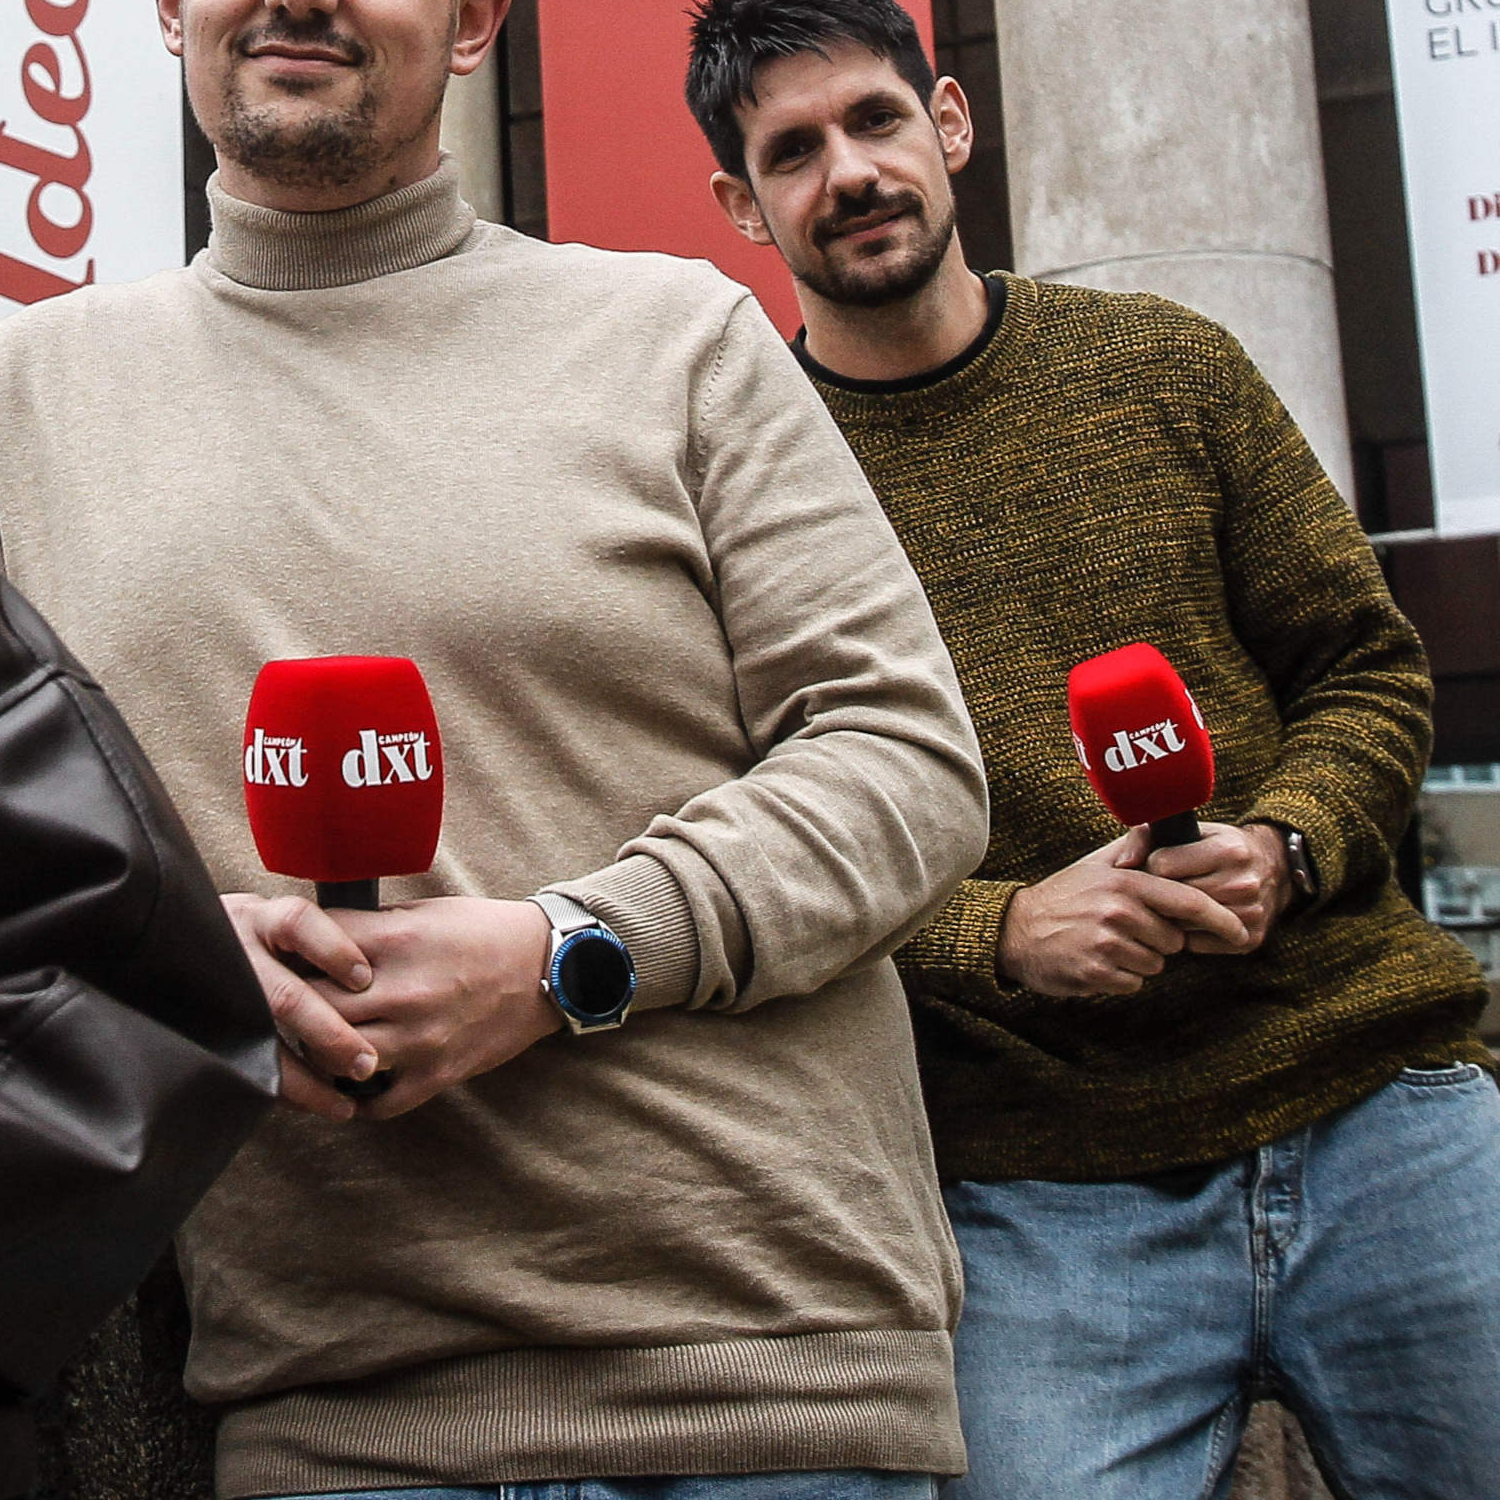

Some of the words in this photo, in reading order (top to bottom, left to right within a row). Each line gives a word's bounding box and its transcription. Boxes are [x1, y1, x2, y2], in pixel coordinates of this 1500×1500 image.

[1428, 26, 1479, 60] EL
[244, 728, 309, 787] dxt
[342, 729, 433, 788] dxt
[377, 731, 419, 745] CAMPEÓN
[1104, 718, 1186, 773] dxt
